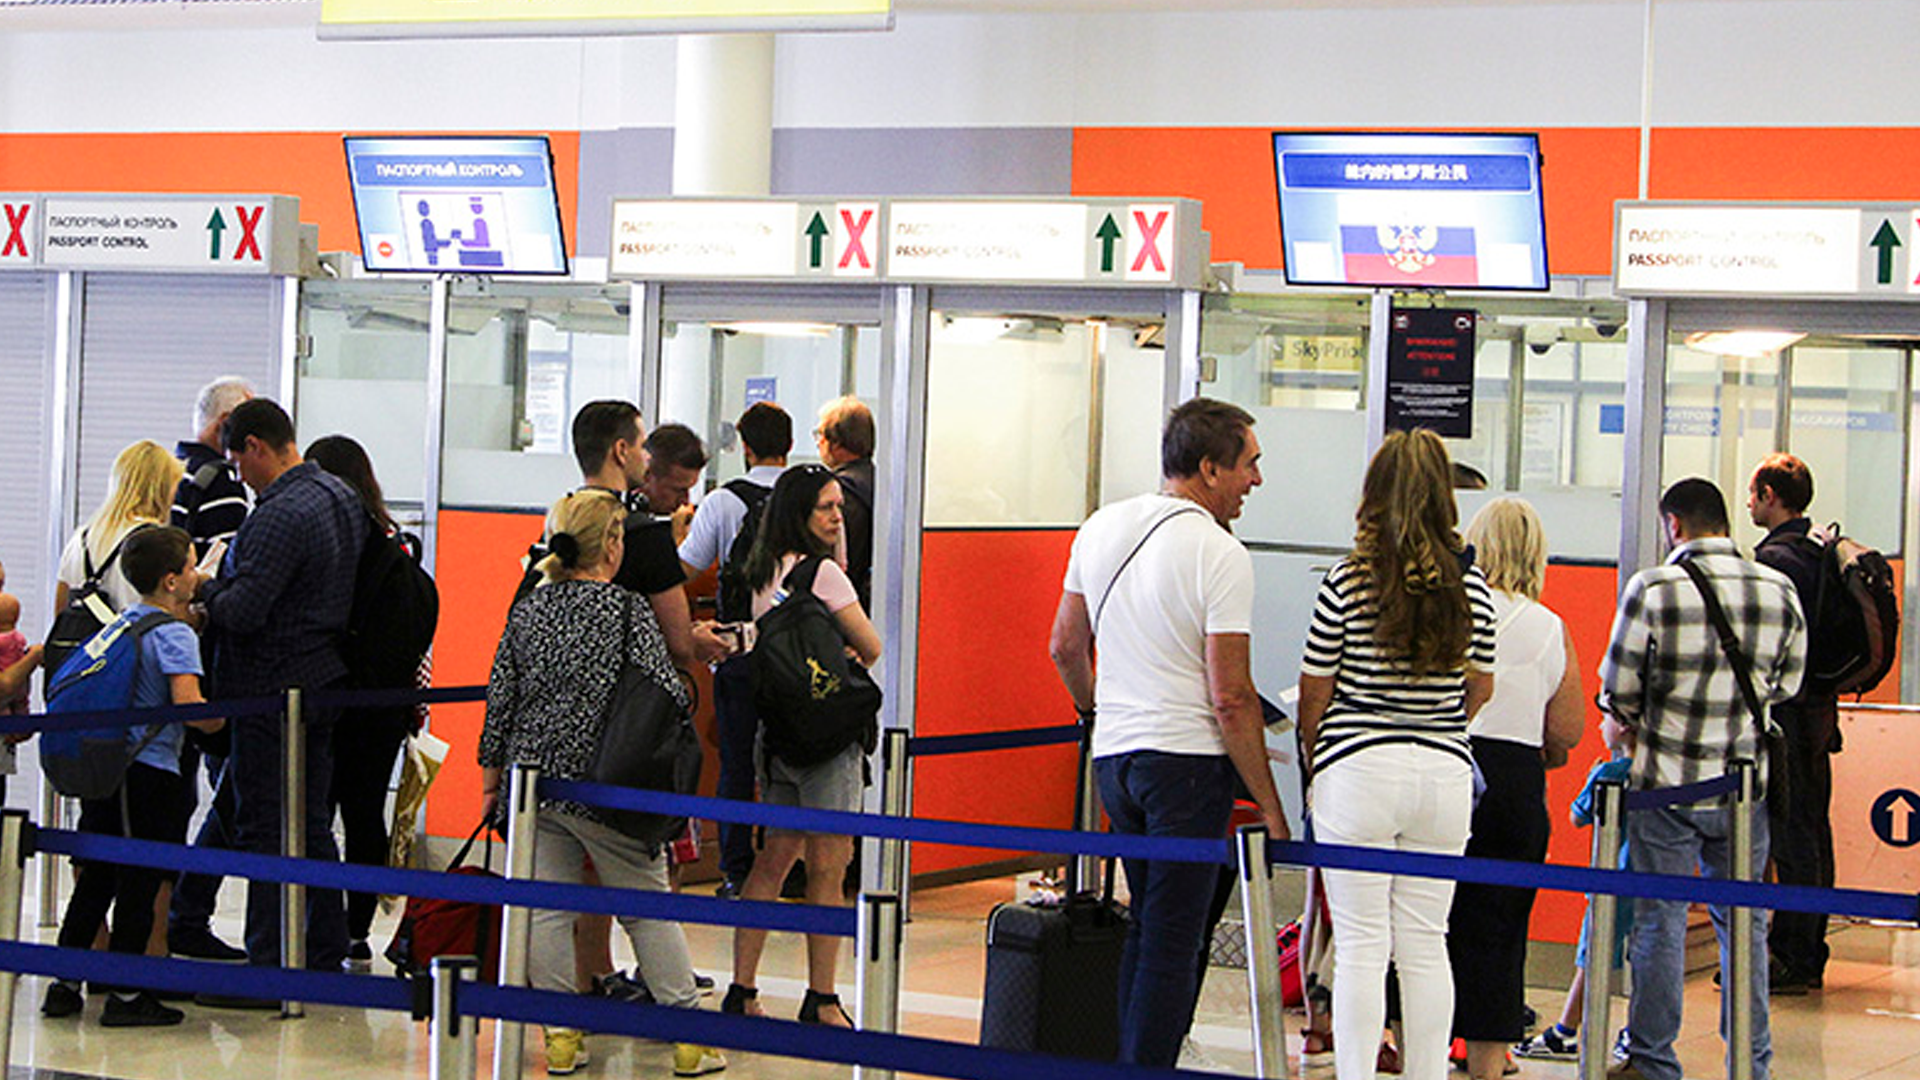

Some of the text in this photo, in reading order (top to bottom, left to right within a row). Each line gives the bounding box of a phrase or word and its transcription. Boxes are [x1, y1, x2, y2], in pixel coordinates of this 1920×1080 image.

[376, 161, 524, 178] ПАСПОРТНЫЙ КОНТРОЛЬ
[48, 215, 179, 230] ПАСПОРТНЫЙ КОНТРОЛЬ
[48, 235, 149, 249] PASSPORT CONTROL
[618, 242, 679, 256] PASSPORT
[894, 244, 958, 258] PASSPORT
[1627, 252, 1783, 270] PASSPORT CONTROL
